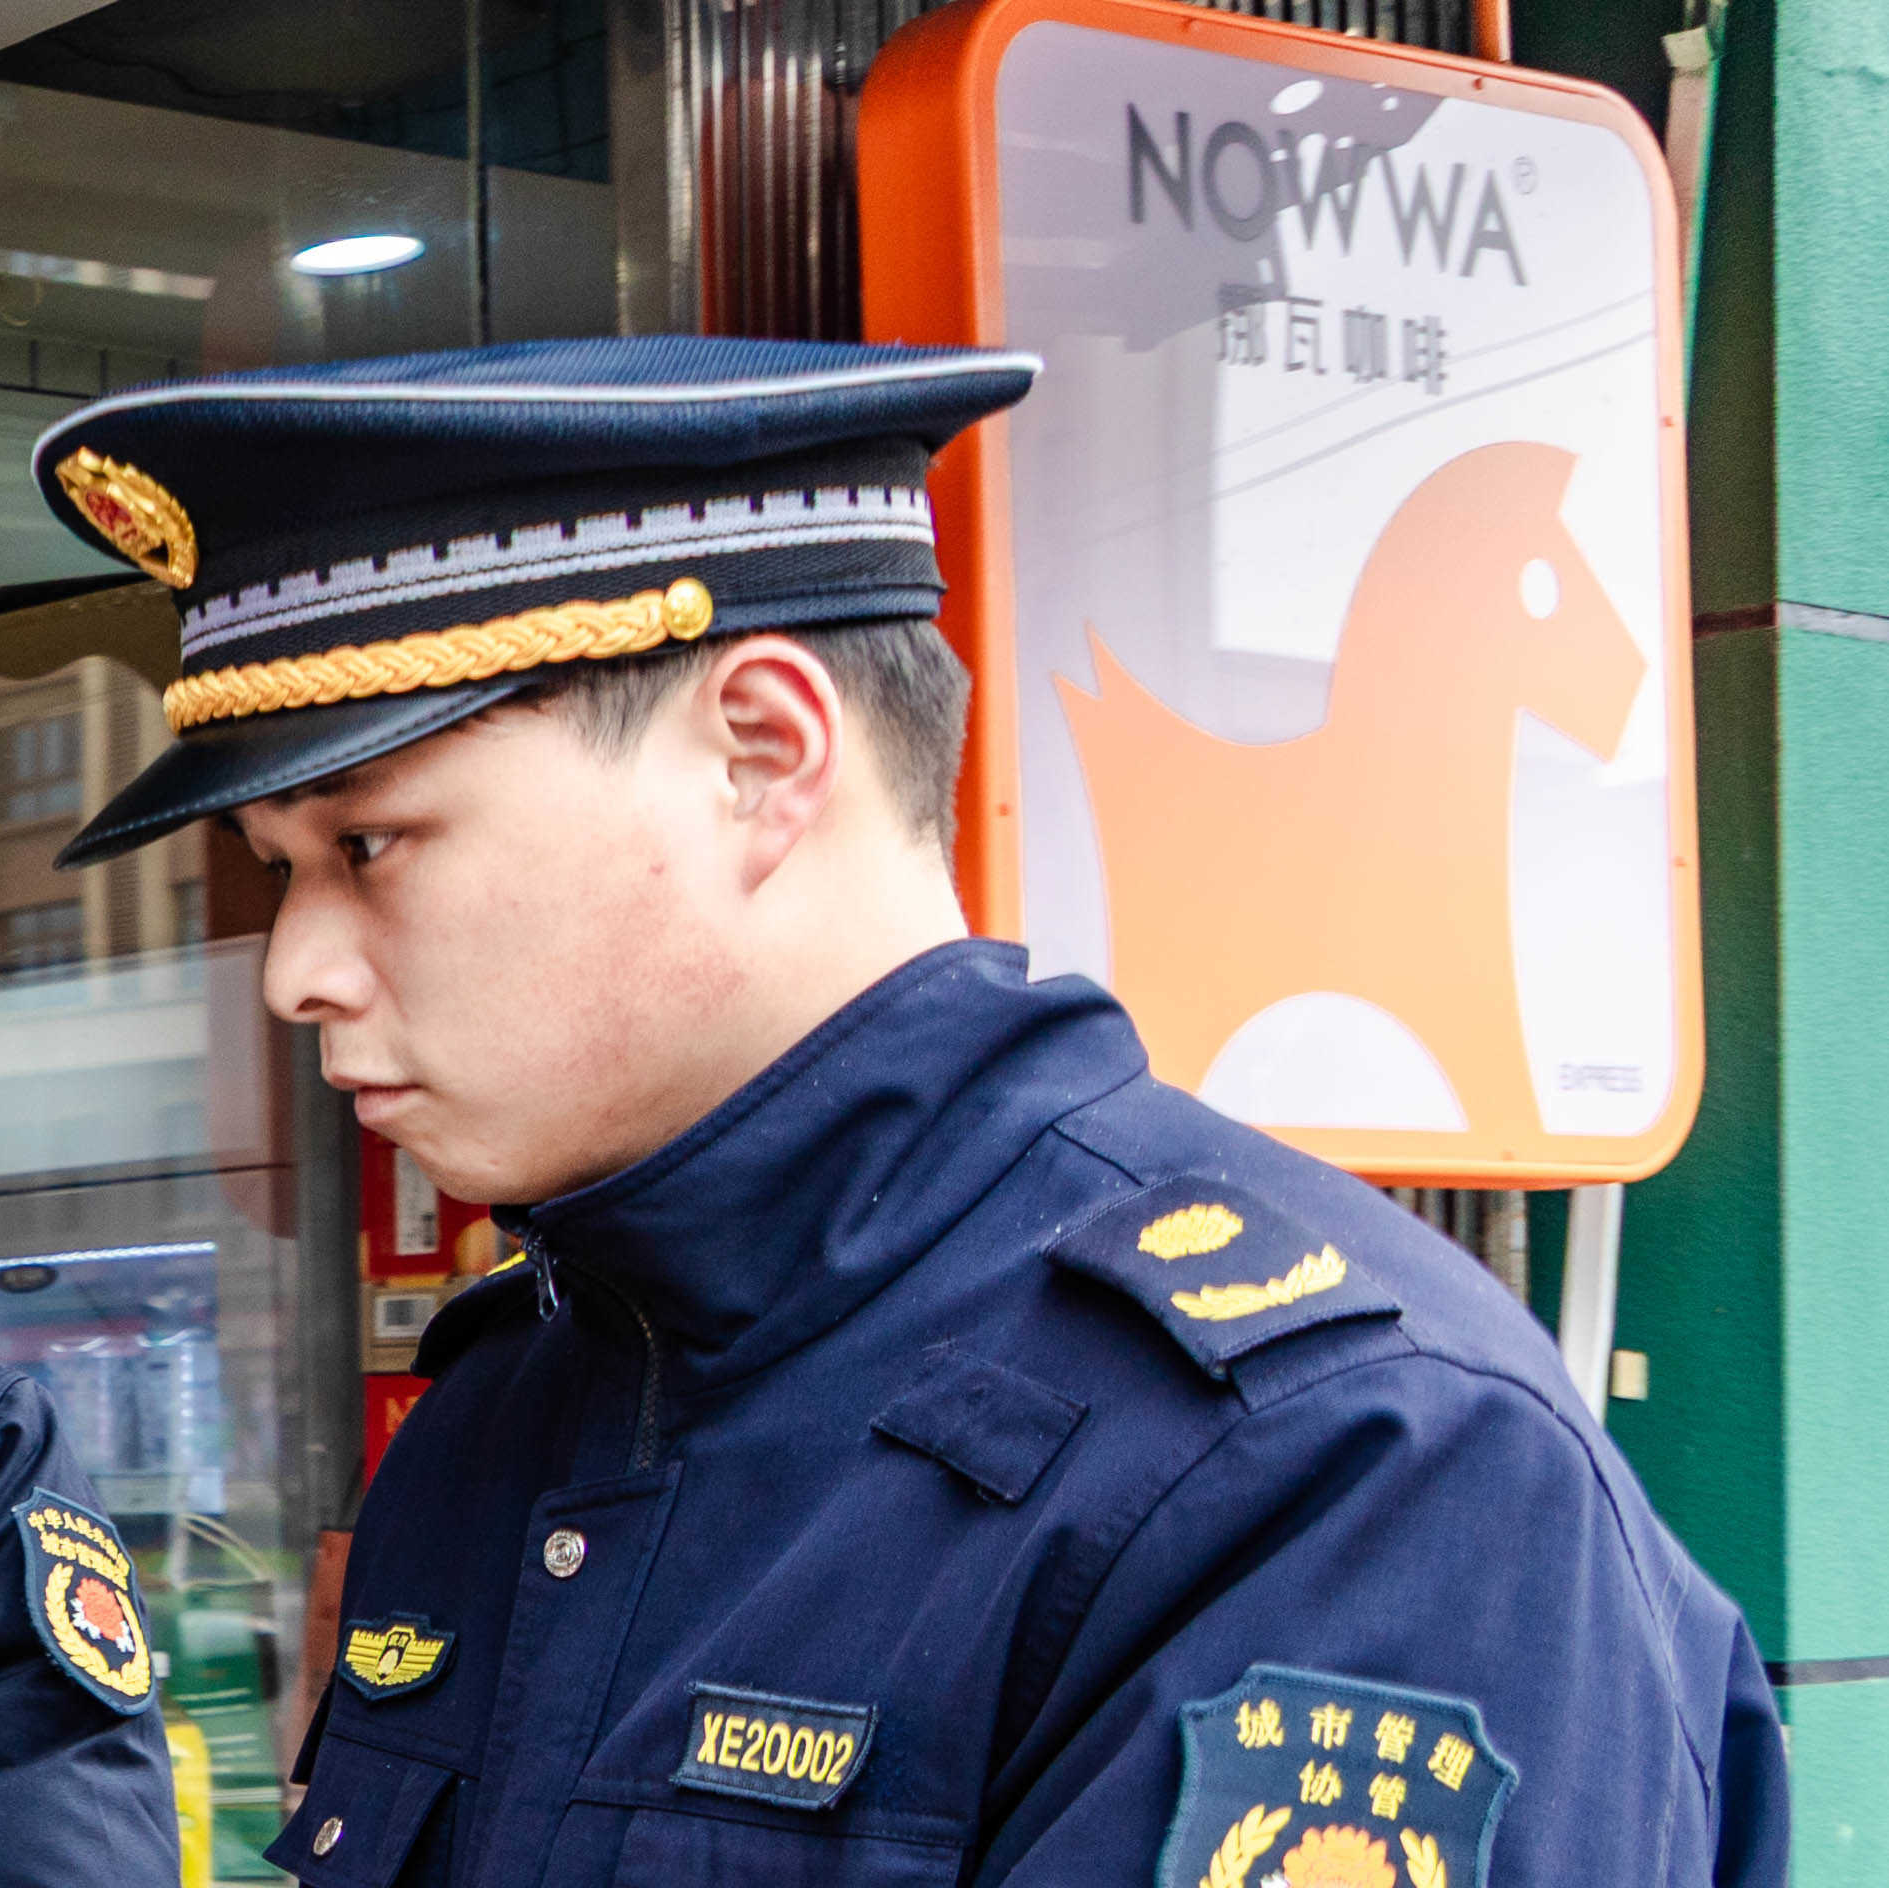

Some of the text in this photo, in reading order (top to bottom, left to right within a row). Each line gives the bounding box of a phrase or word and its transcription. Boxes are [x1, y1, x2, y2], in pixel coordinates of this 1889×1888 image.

[1124, 101, 1527, 287] NOWWA
[697, 1711, 854, 1785] XE20002
[1234, 1697, 1475, 1791] 城市管理
[1298, 1758, 1408, 1820] 协管
